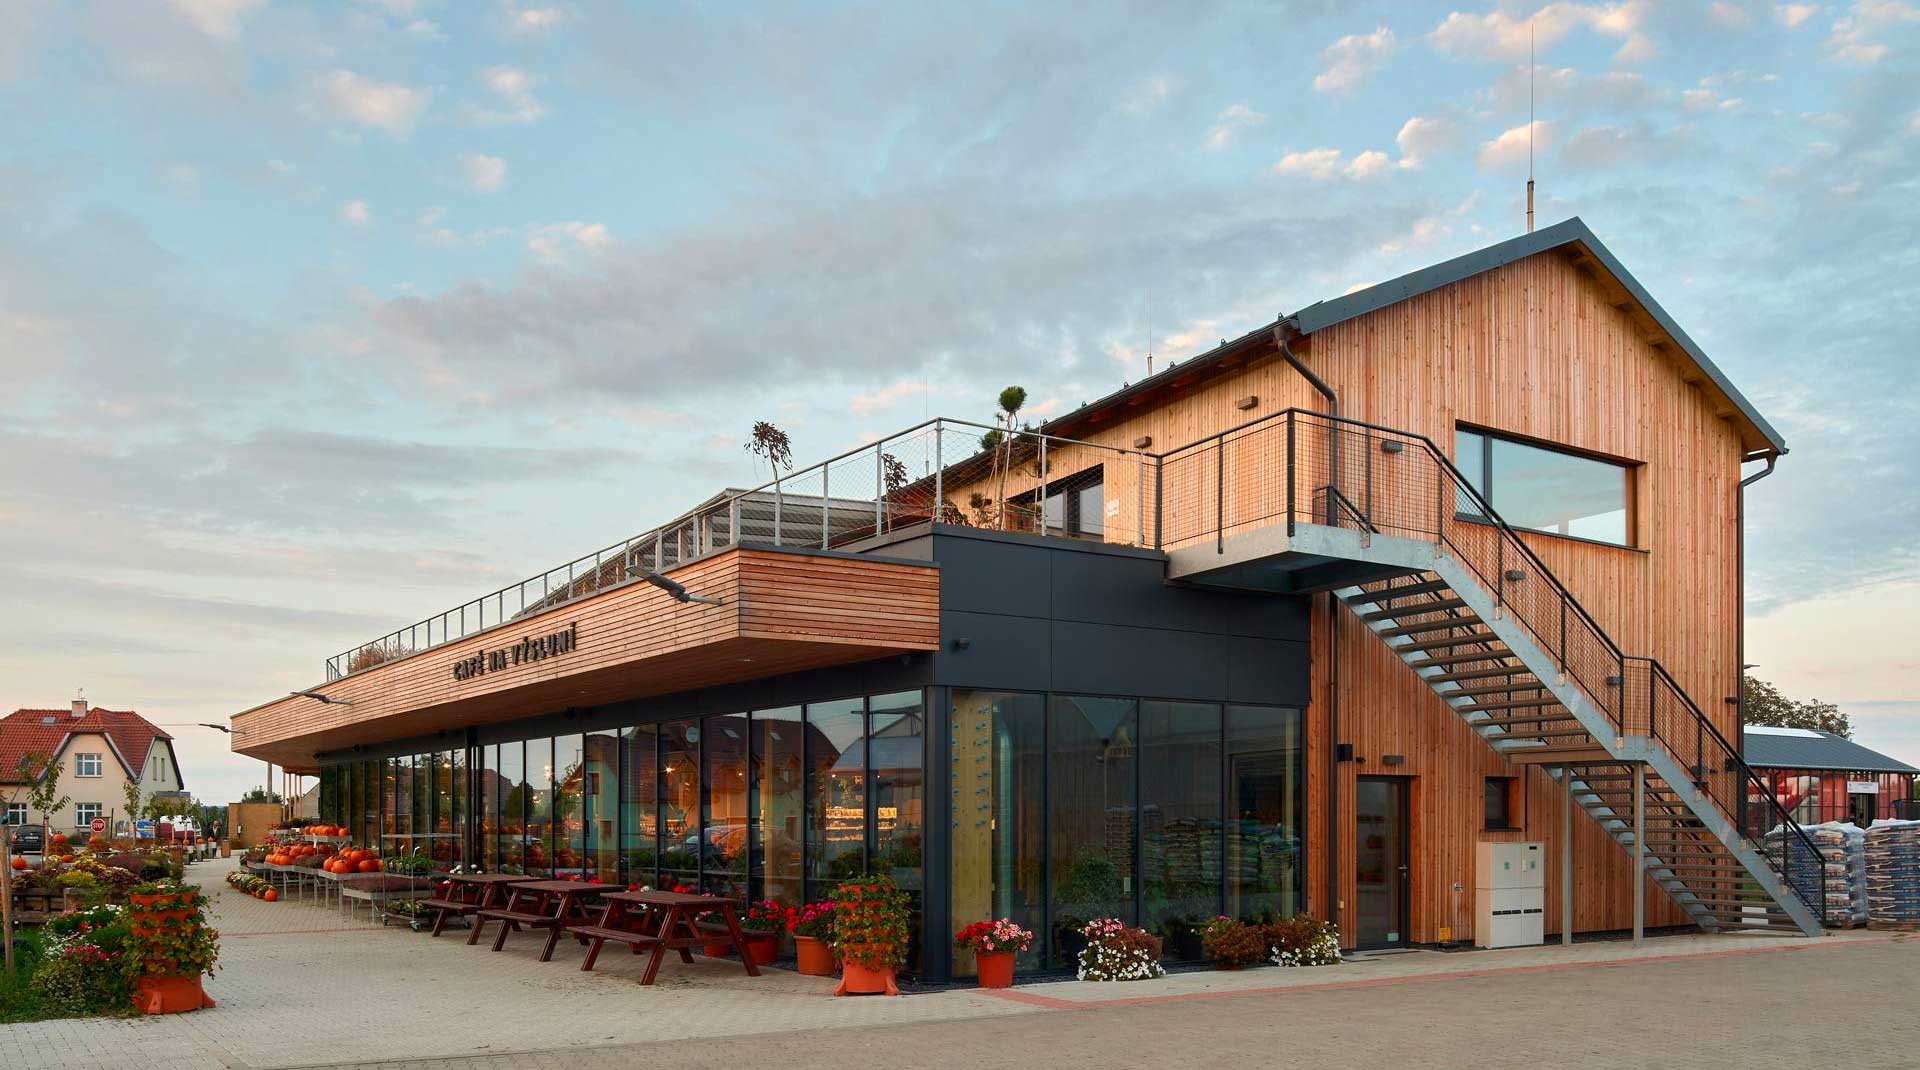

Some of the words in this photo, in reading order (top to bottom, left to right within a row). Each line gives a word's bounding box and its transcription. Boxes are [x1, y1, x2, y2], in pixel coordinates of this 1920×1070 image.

[453, 650, 484, 681] CAFÉ
[488, 648, 507, 672] NA
[511, 621, 577, 666] VÝSLUNÍ
